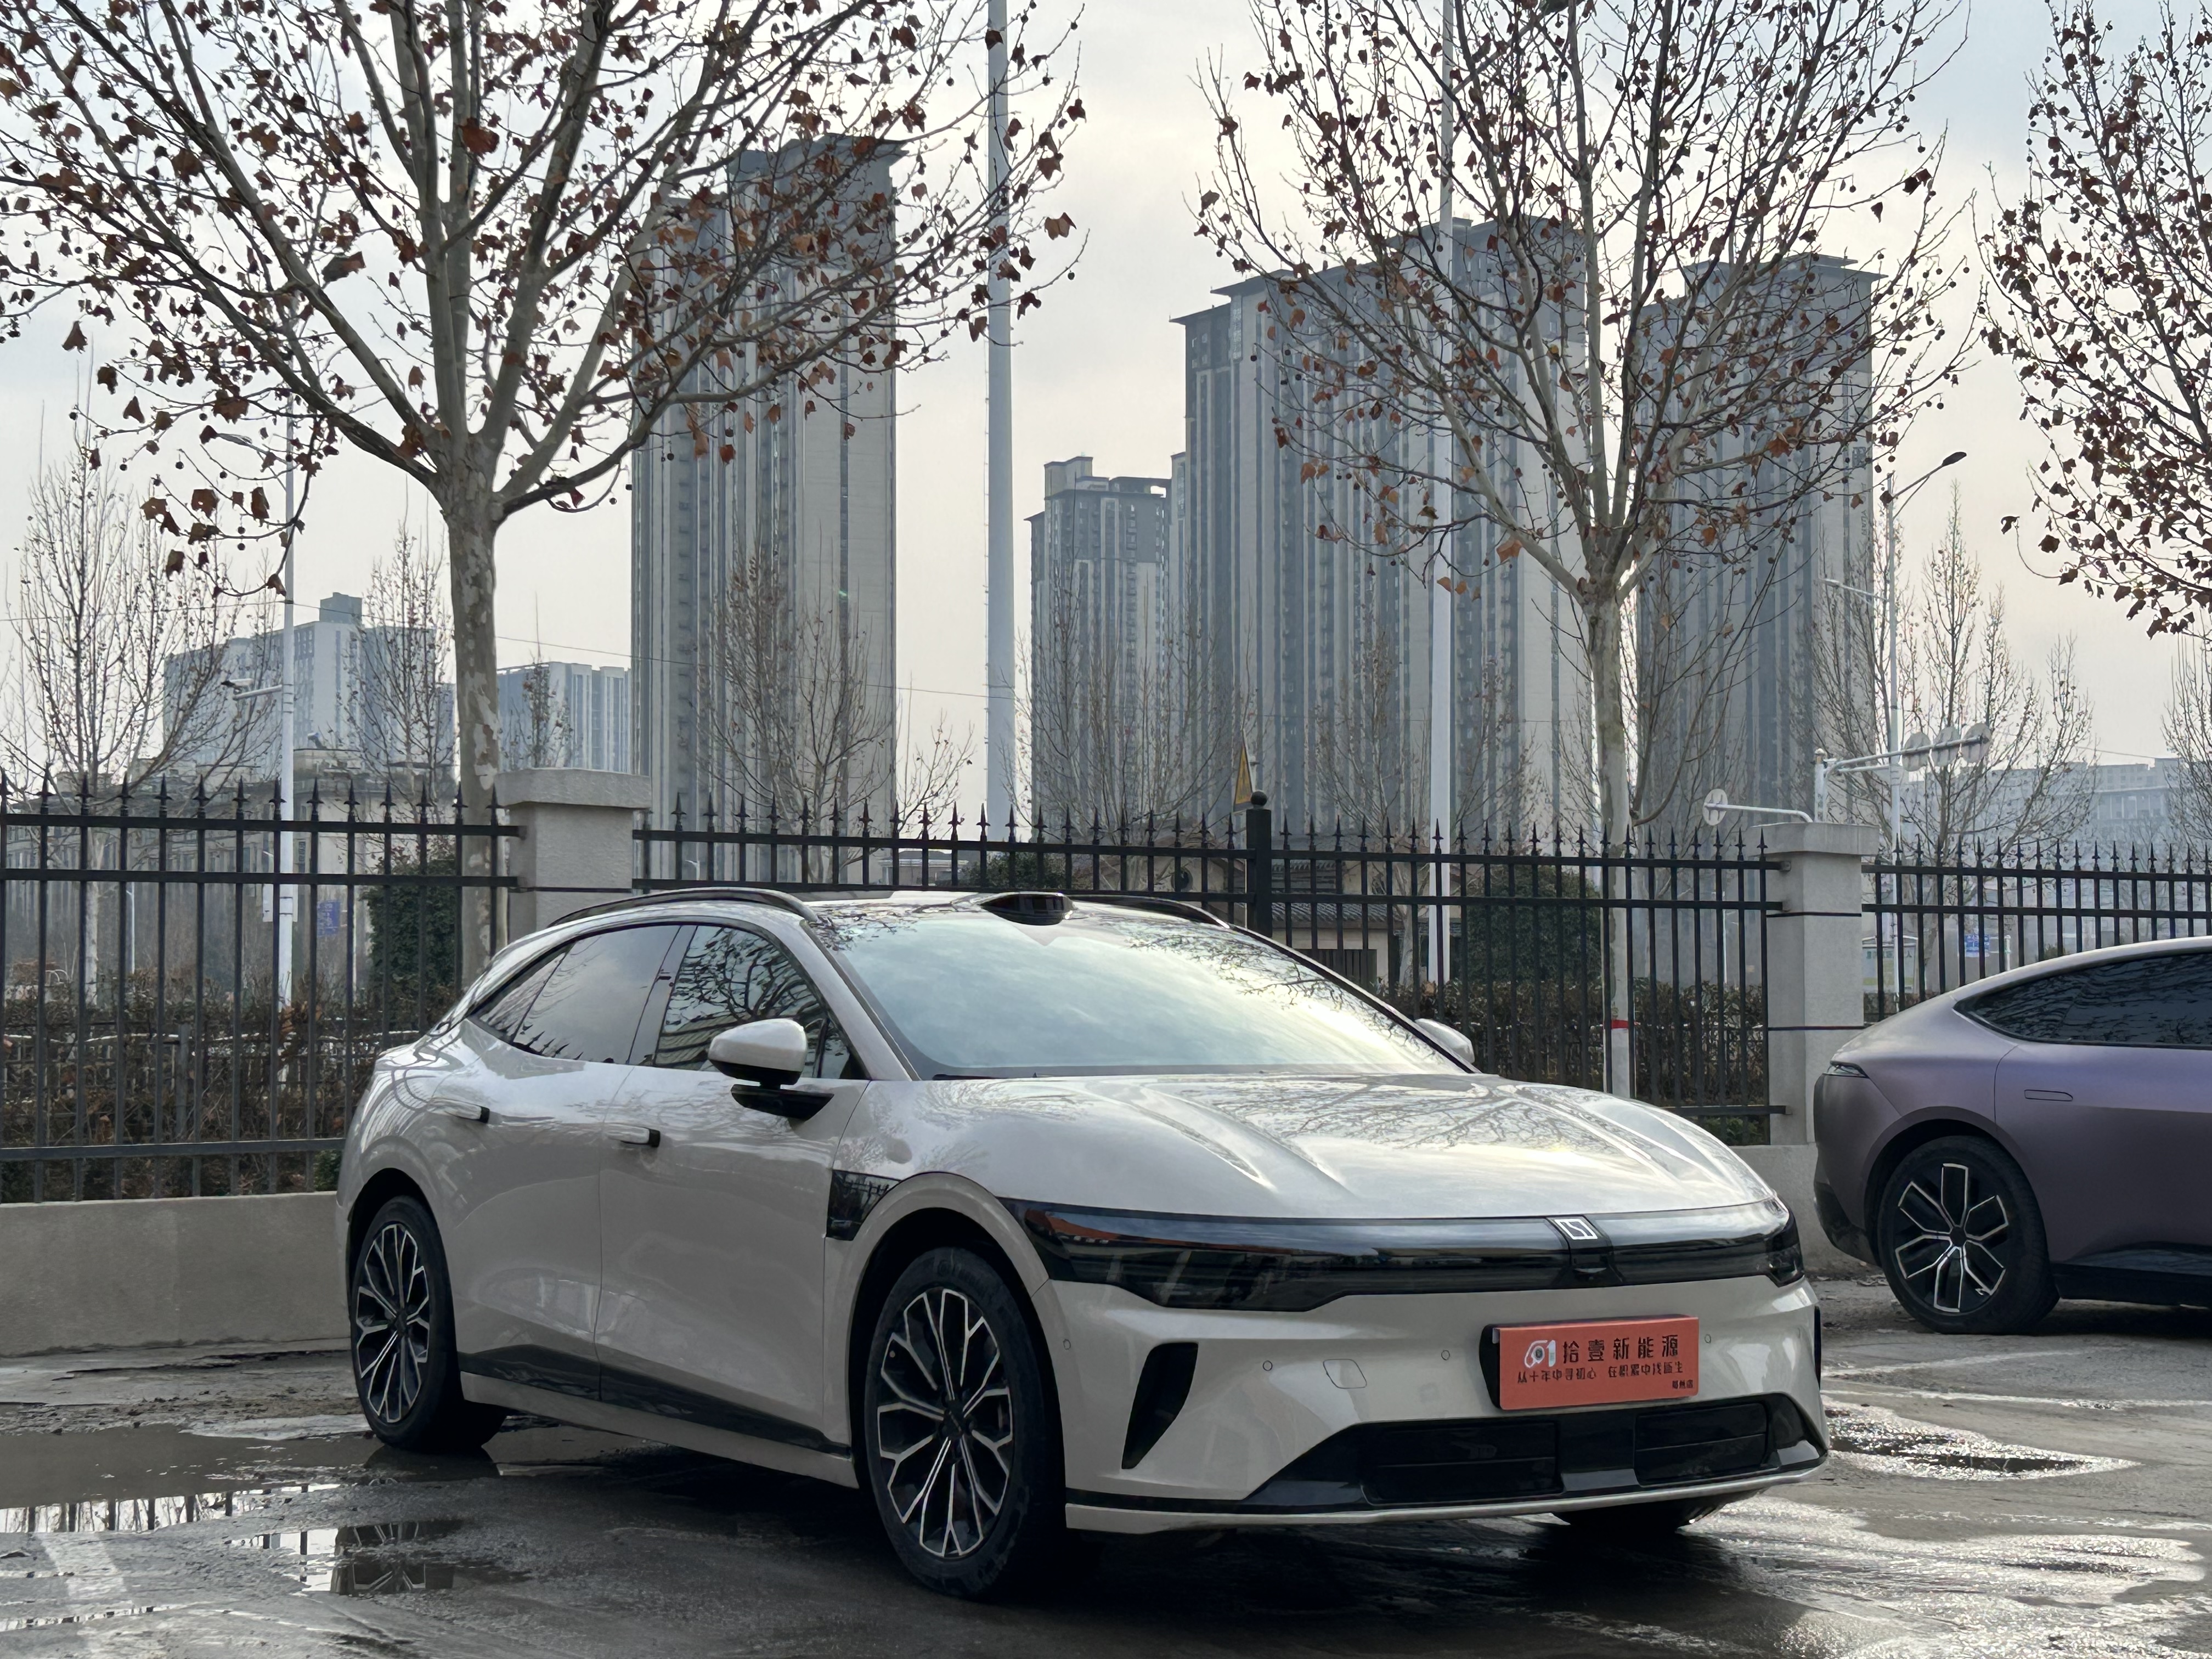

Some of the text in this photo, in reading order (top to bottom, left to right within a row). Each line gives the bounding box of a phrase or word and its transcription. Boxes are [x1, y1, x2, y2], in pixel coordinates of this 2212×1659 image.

[1562, 1334, 1679, 1364] 拾壹新能源
